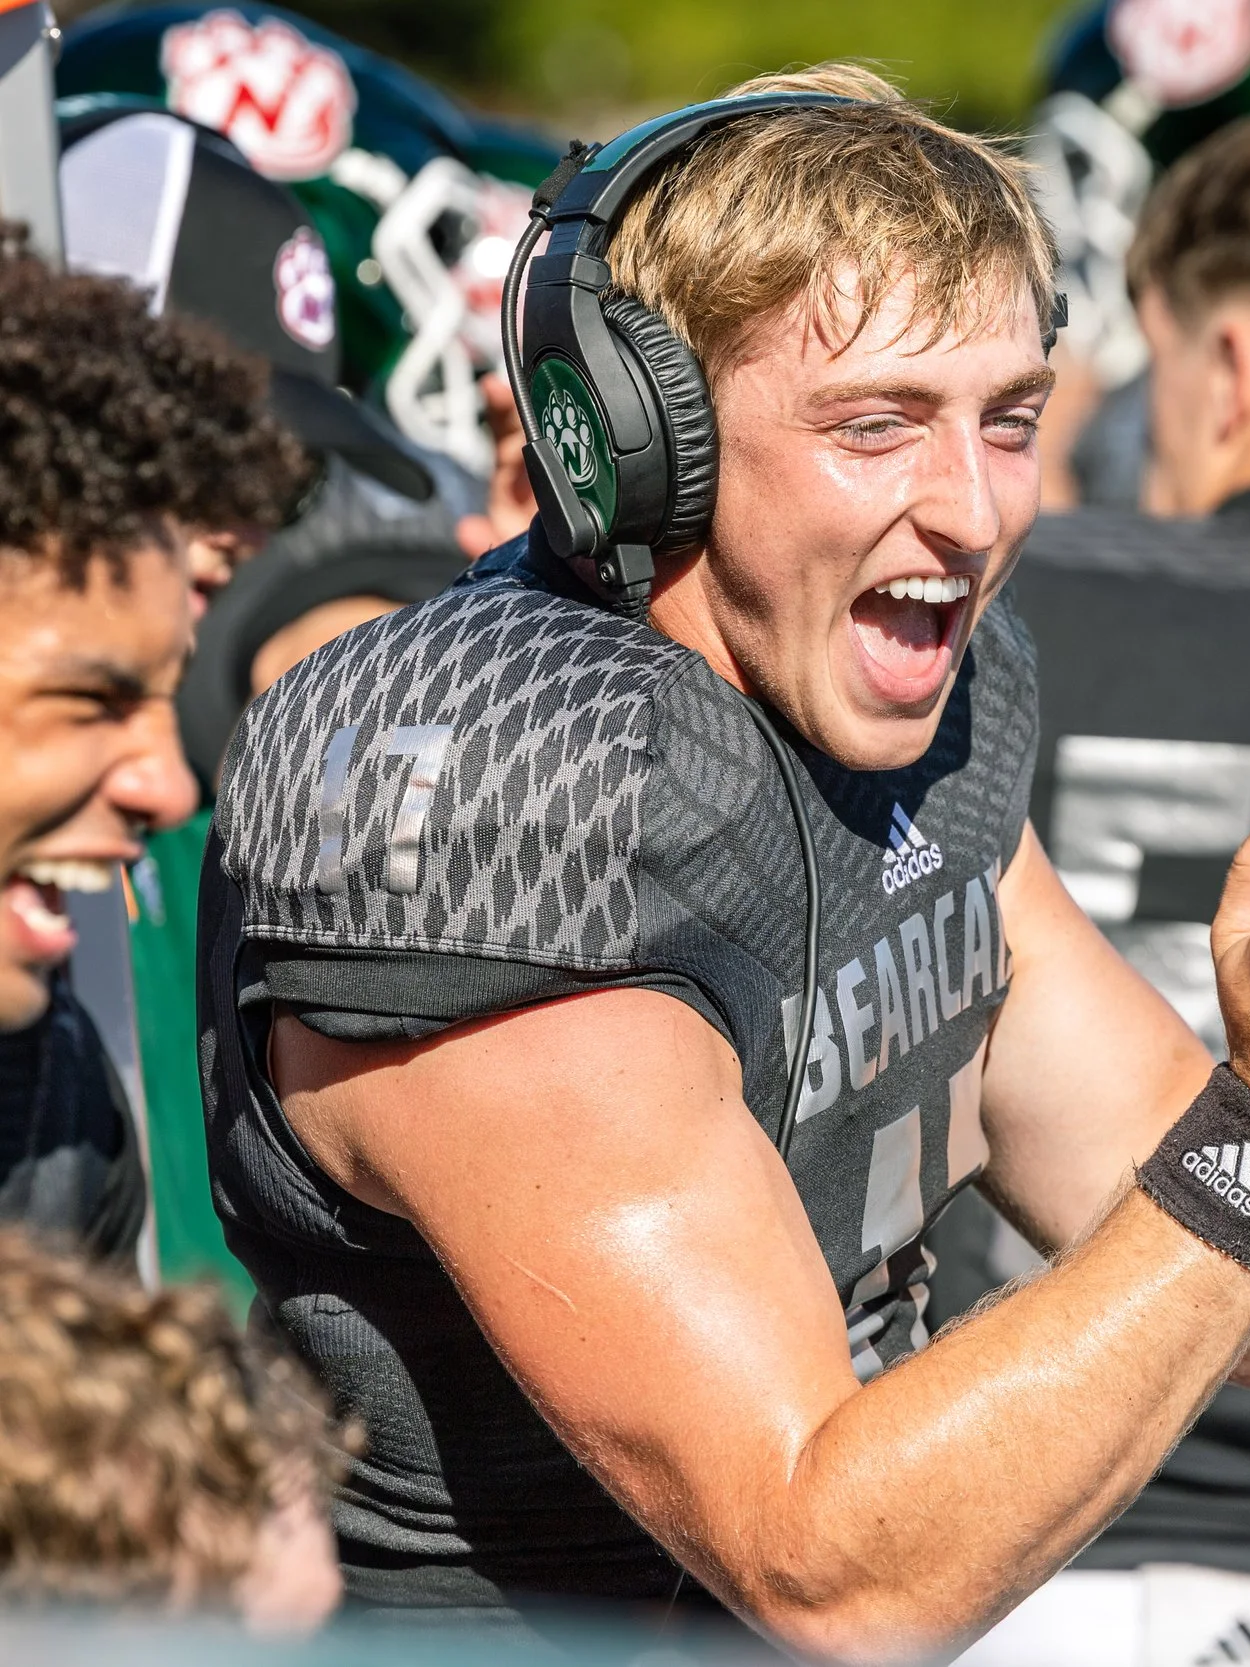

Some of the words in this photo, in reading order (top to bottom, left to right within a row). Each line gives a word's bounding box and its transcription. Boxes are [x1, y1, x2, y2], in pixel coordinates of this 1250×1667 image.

[317, 723, 455, 894] 17
[881, 843, 944, 895] adidas
[781, 856, 1013, 1124] BEARCAT
